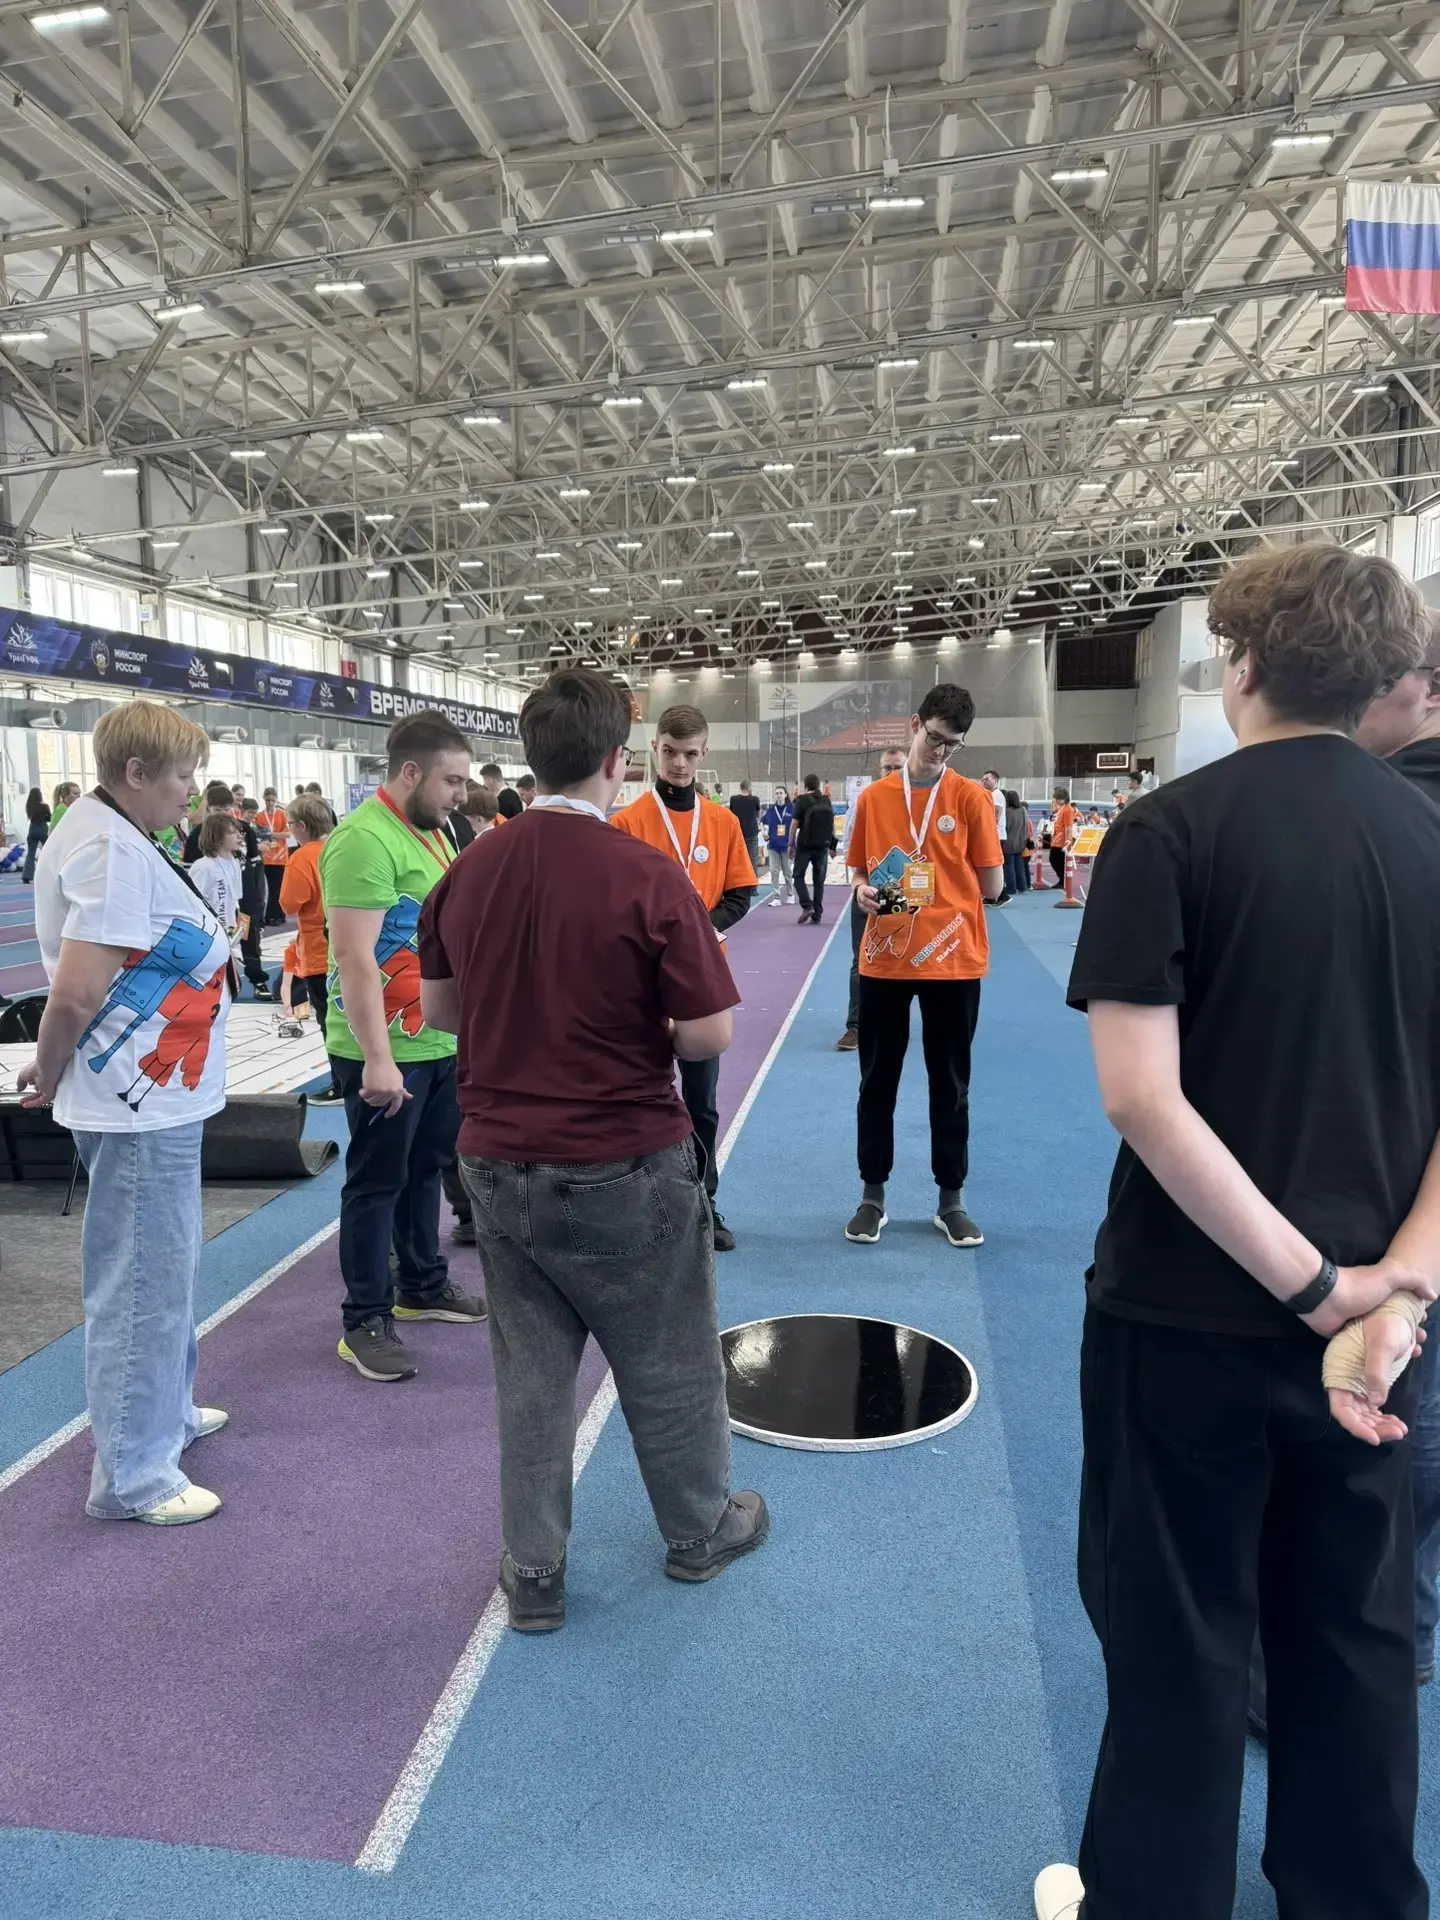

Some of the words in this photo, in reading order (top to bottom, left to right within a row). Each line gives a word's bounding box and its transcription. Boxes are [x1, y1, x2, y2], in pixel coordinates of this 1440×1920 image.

[114, 648, 148, 663] МИНСПОРТ
[115, 662, 142, 675] РОССИИ
[269, 676, 293, 687] МИНСПОРТ
[270, 687, 289, 697] РОССИИ
[216, 878, 226, 900] TEAM
[936, 938, 961, 964] StarLine
